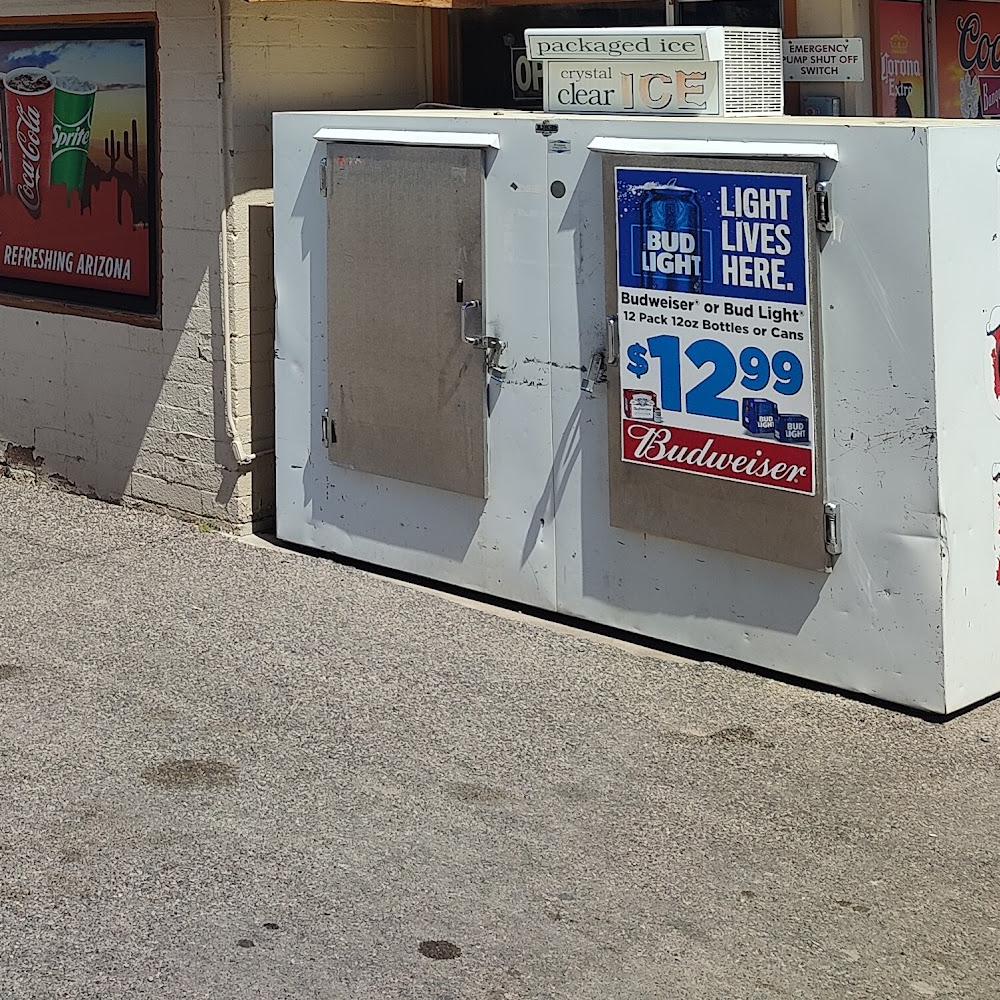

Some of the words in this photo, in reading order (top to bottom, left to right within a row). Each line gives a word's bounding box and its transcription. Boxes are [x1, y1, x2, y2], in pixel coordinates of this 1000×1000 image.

[537, 37, 649, 57] packaged
[660, 39, 696, 53] ice
[789, 44, 849, 53] EMERGENCY
[810, 55, 837, 64] SHUT
[839, 55, 858, 64] OFF
[515, 55, 543, 92] OP
[800, 66, 839, 75] SWITCH
[880, 52, 922, 83] Corona
[557, 83, 616, 106] clear
[560, 67, 613, 82] crystal
[620, 69, 707, 111] ICE
[52, 124, 90, 148] Sprite
[720, 186, 792, 221] LIGHT
[646, 229, 696, 254] BUD
[721, 219, 792, 256] LIVES
[4, 245, 73, 273] REFRESHING
[76, 253, 132, 280] ARIZONA
[641, 250, 702, 277] LIGHT
[722, 254, 794, 292] HERE.
[704, 303, 719, 314] or
[724, 302, 754, 318] Bud
[623, 310, 636, 322] 12
[640, 312, 668, 326] Pack
[671, 316, 699, 329] 12oz
[702, 319, 749, 335] Bottles
[753, 327, 767, 337] or
[771, 327, 804, 341] Cans
[784, 429, 806, 439] LIGHT
[786, 422, 804, 430] BUD
[627, 424, 807, 484] Budweiser
